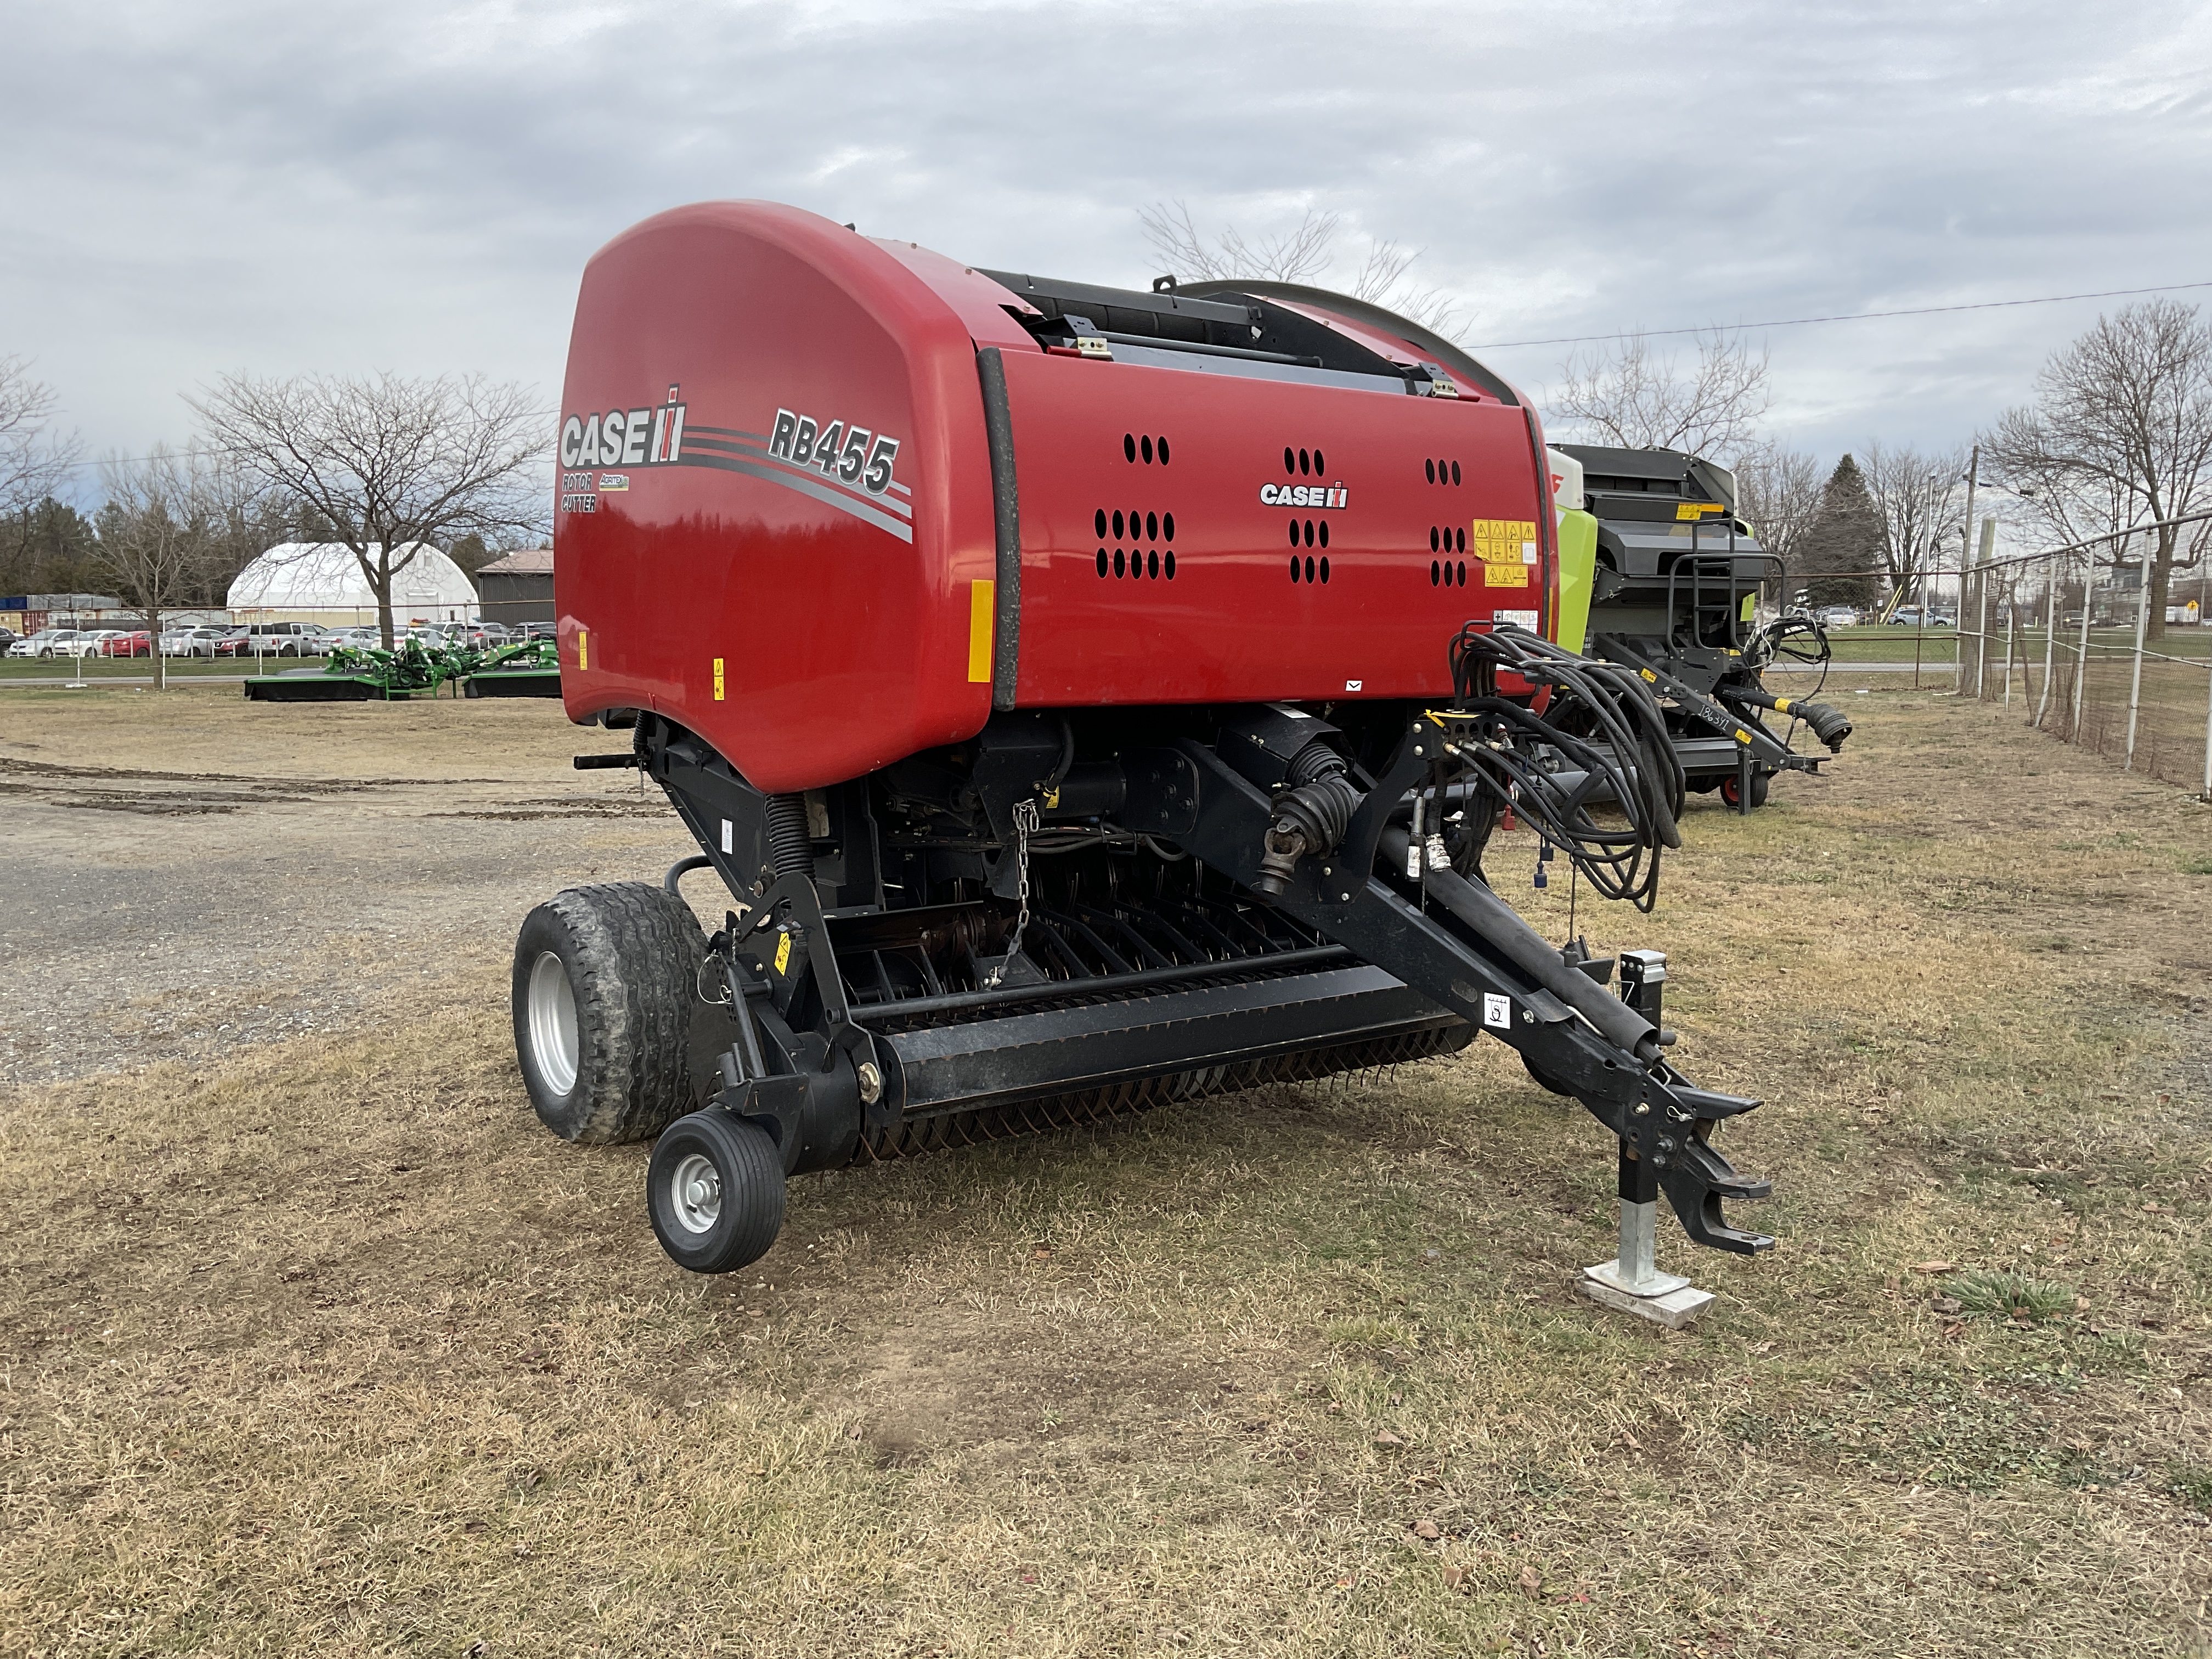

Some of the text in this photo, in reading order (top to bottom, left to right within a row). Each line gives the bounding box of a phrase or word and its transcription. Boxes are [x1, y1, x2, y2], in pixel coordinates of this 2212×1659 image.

[561, 411, 650, 467] CASE
[768, 408, 900, 495] RB455
[562, 473, 592, 492] ROTOR
[562, 494, 596, 512] CUTTER
[1260, 484, 1324, 506] CASE
[1698, 704, 1729, 731] 186341
